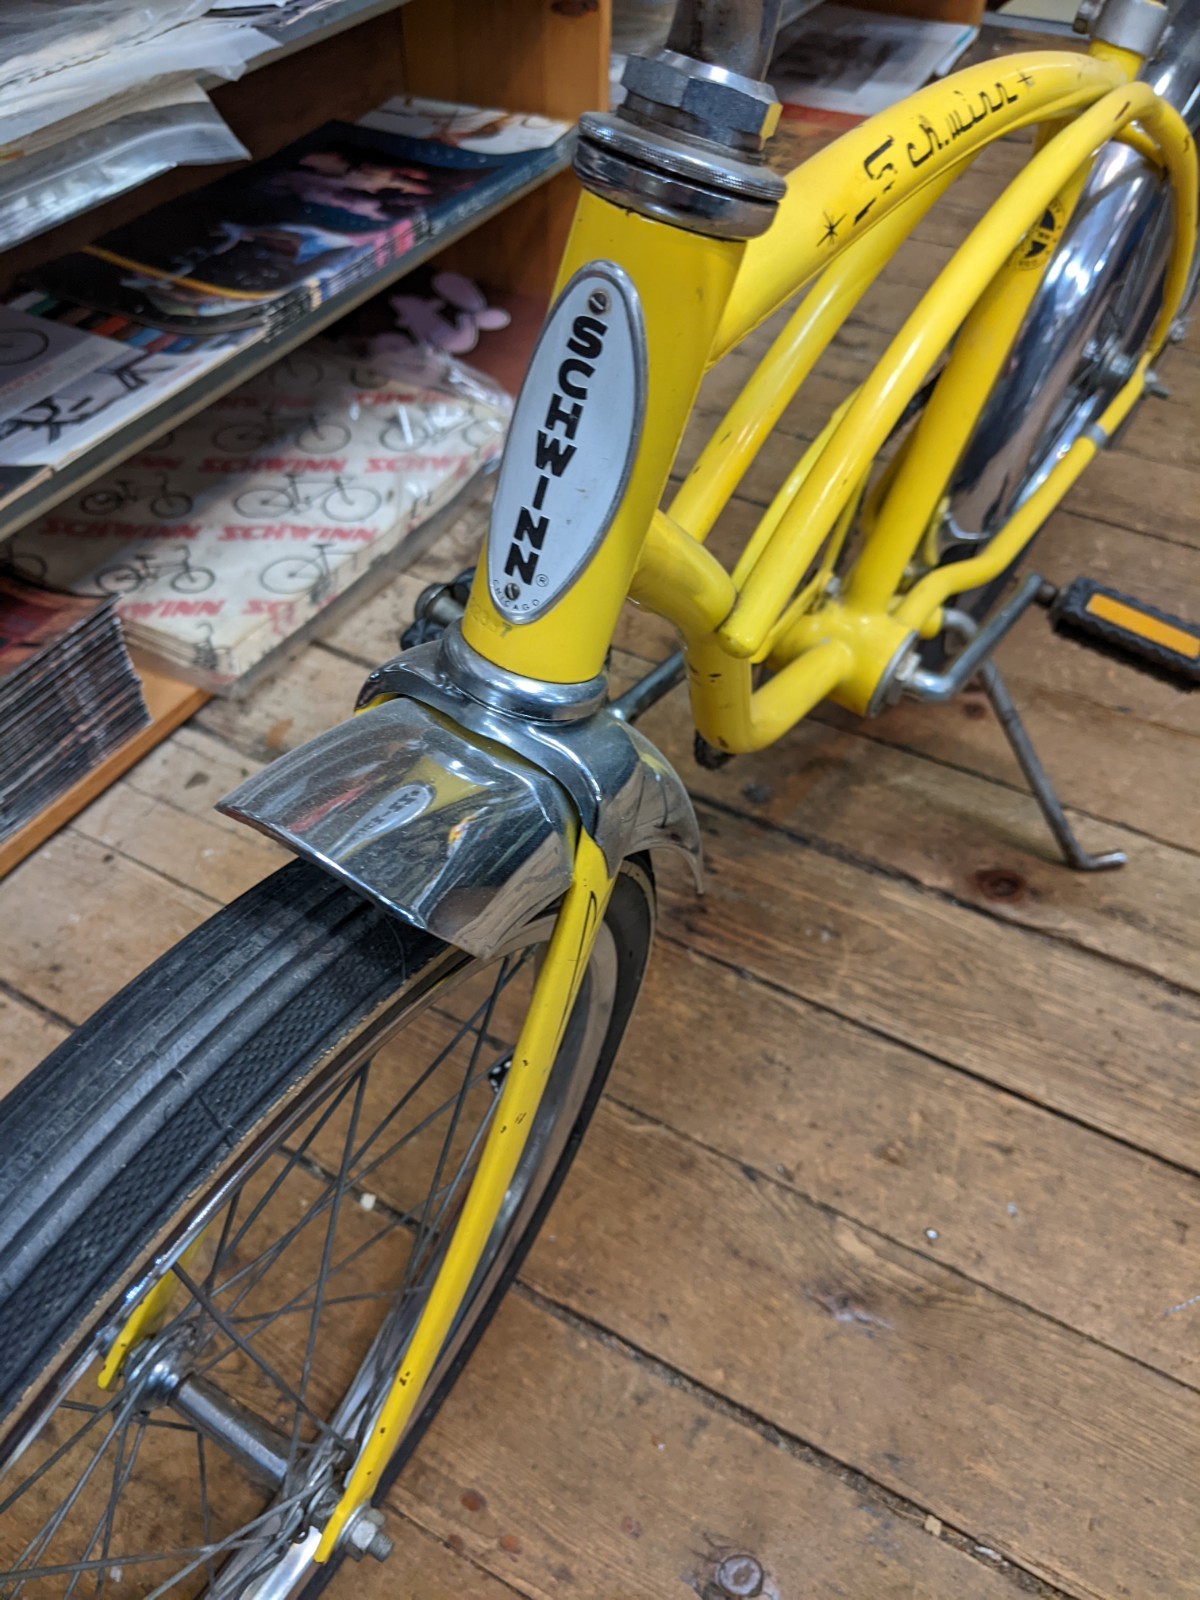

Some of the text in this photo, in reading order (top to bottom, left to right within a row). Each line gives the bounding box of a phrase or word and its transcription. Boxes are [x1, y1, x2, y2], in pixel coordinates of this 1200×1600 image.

[505, 315, 608, 585] SCHWINN
[218, 524, 378, 541] SCHWINN
[493, 579, 540, 611] CHICAGO
